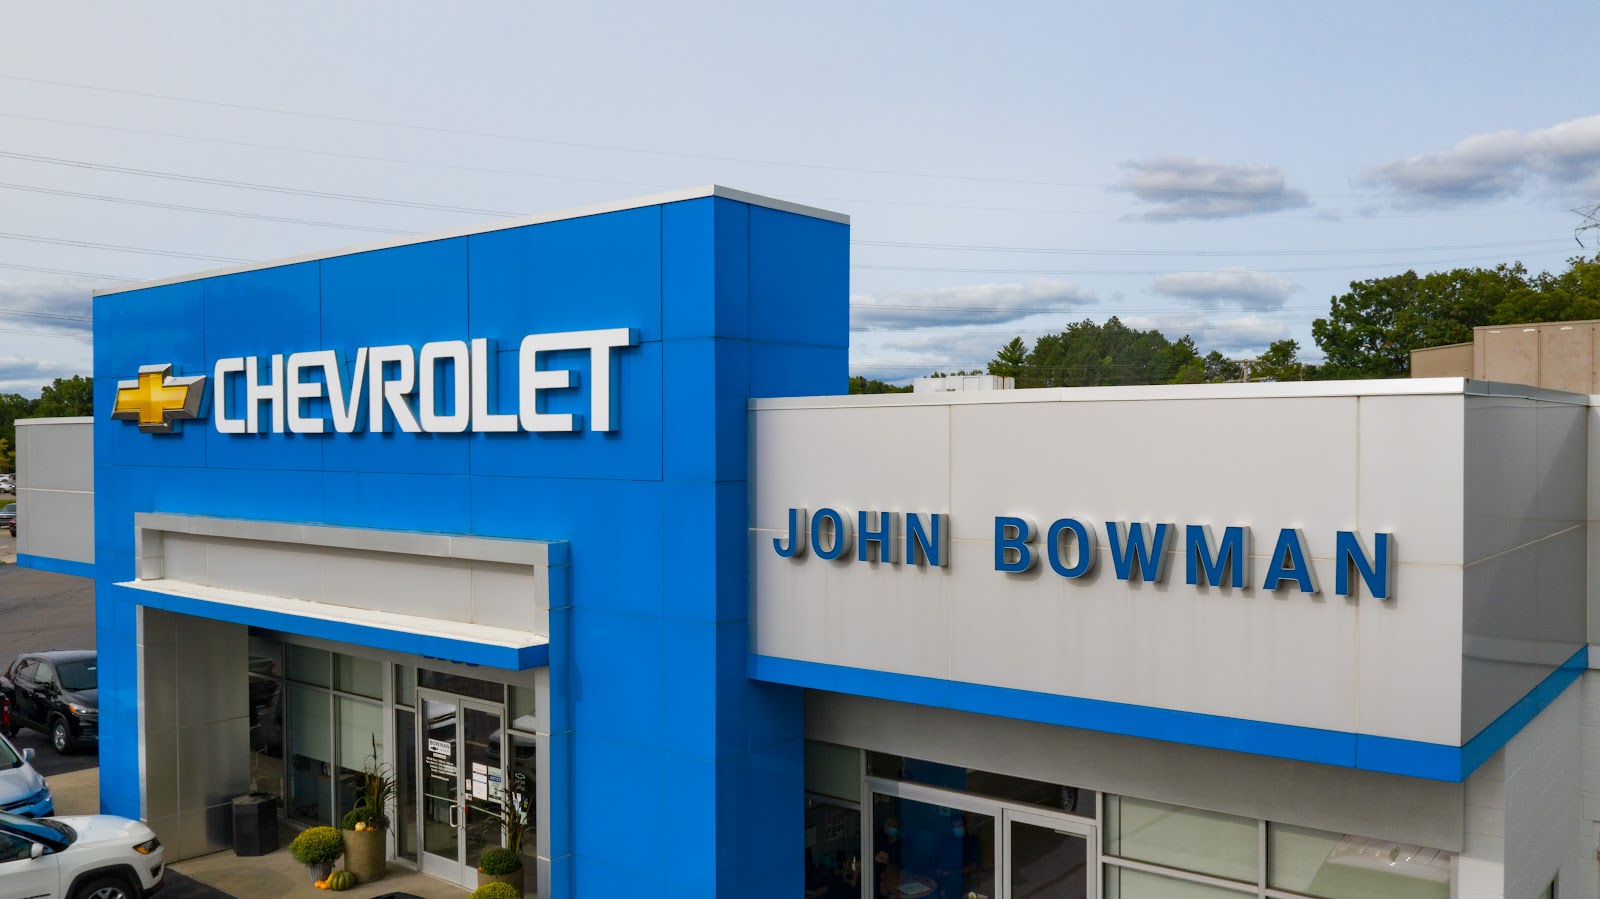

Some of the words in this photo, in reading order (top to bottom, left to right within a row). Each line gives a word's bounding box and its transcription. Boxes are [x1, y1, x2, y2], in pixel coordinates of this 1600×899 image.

[214, 327, 632, 435] CHEVROLET
[772, 507, 948, 568] JOHN
[994, 515, 1393, 600] BOWMAN
[430, 740, 450, 749] BOWMAN
